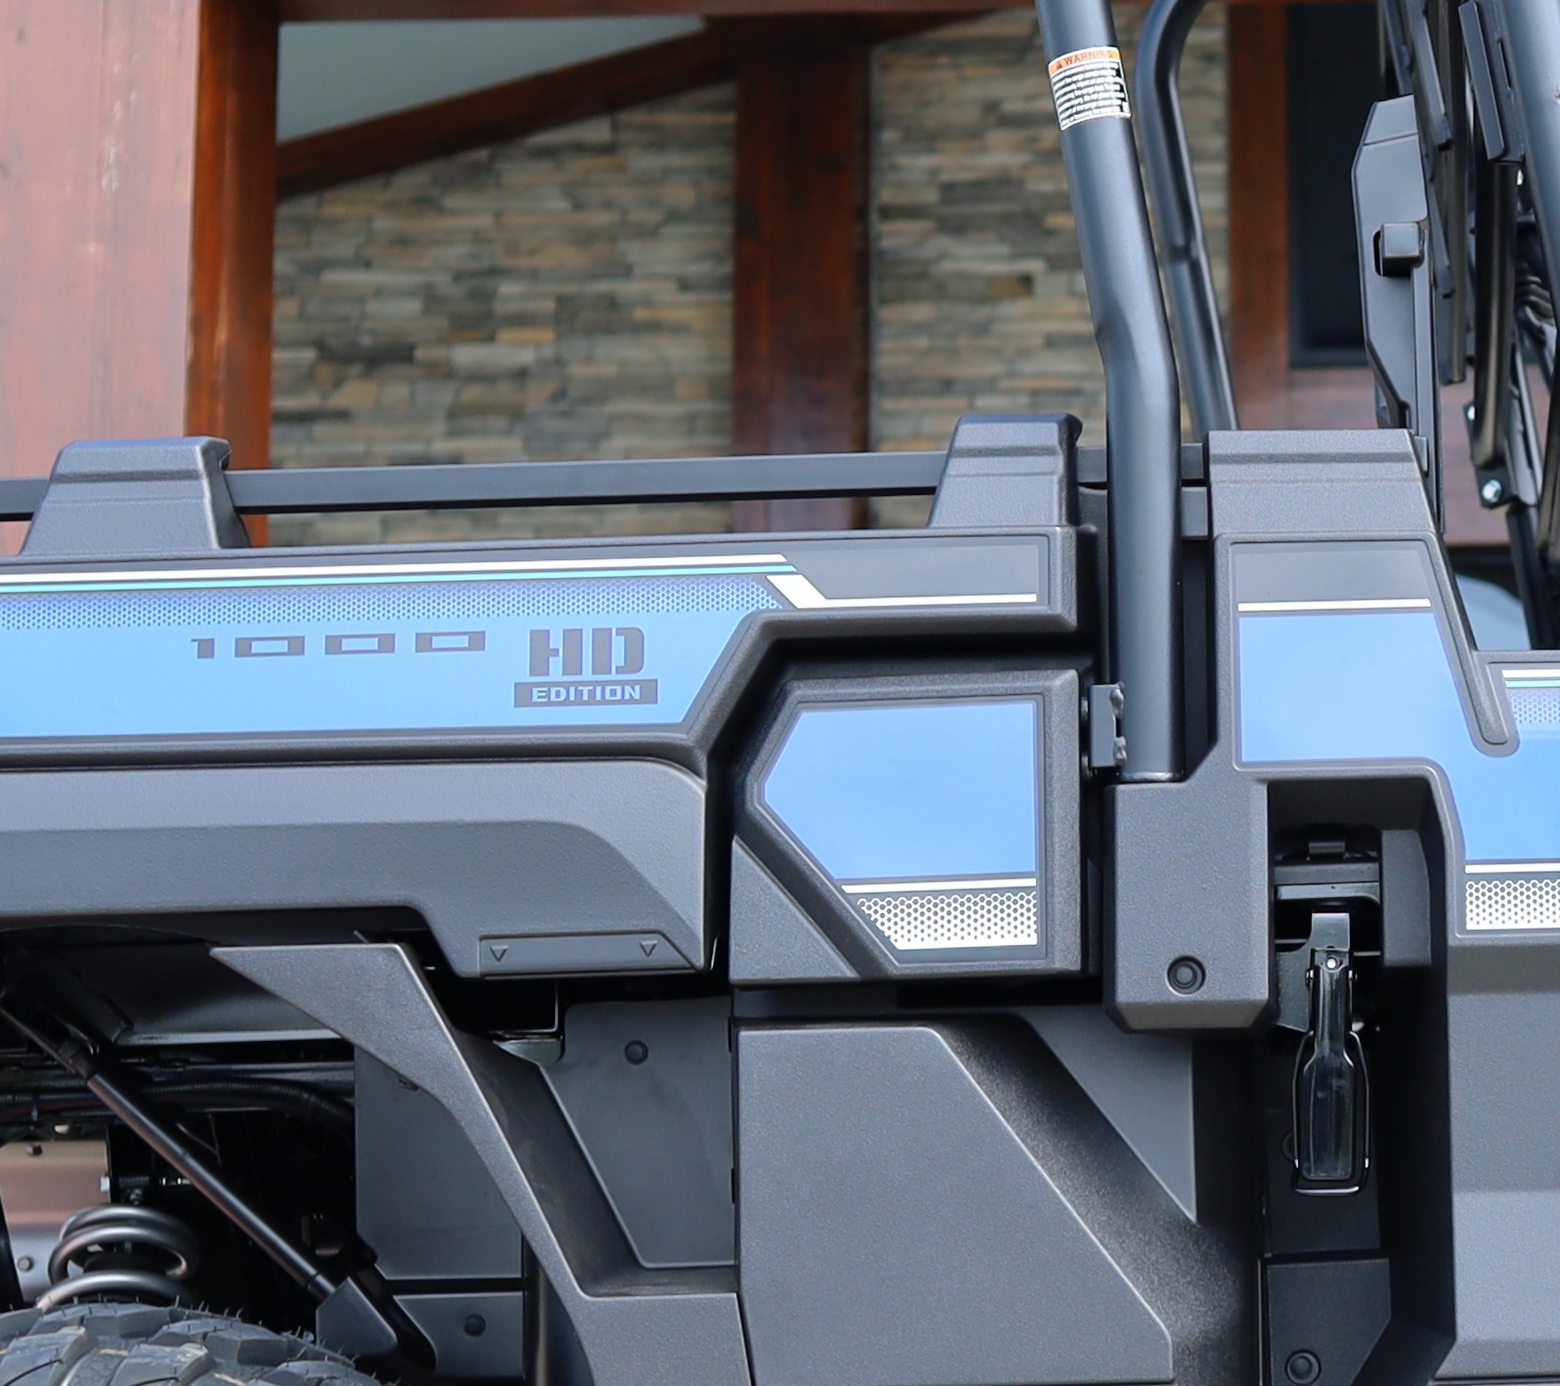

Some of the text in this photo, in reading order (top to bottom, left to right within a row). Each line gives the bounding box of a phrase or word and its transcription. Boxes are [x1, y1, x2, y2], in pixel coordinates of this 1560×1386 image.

[191, 626, 646, 677] 1000 HD
[530, 683, 642, 703] EDITION
